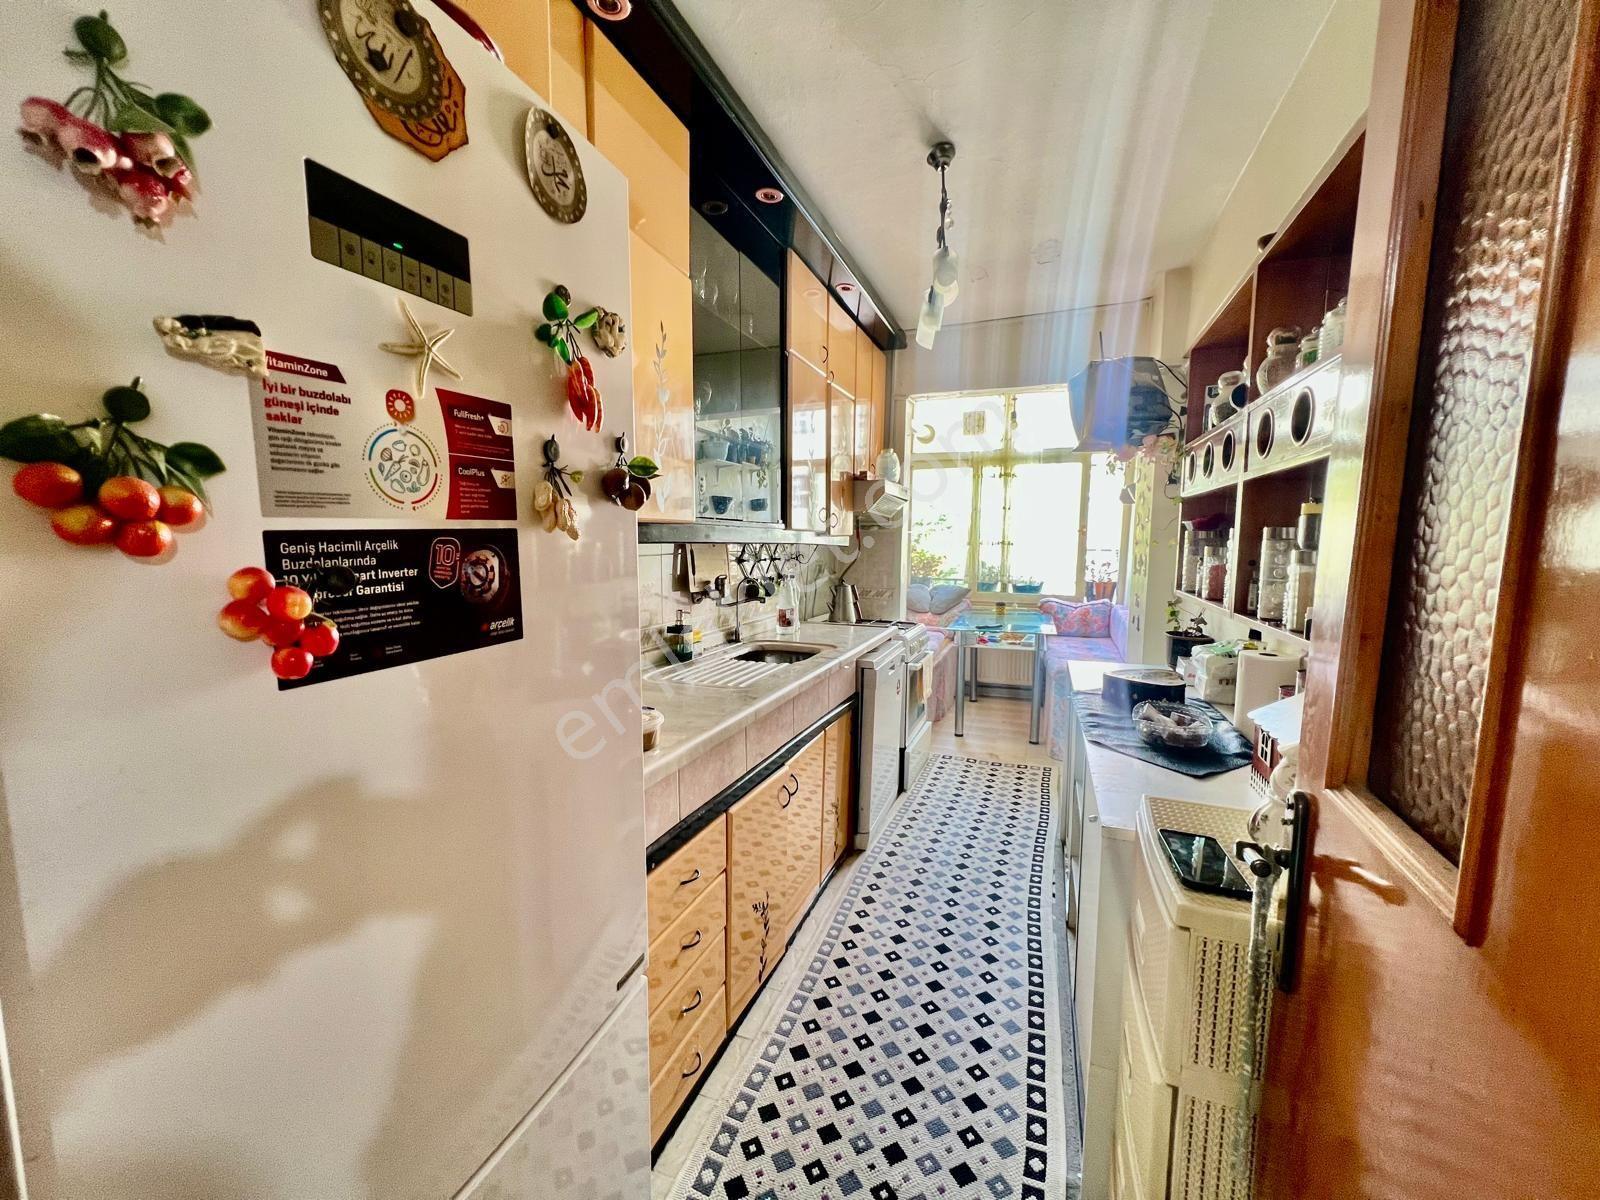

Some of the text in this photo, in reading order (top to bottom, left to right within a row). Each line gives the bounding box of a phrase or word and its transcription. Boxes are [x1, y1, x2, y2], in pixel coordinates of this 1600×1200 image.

[280, 382, 296, 396] bir
[299, 386, 351, 405] buzdolabı
[264, 396, 340, 416] güneşi içinde
[265, 411, 303, 424] saklar
[458, 467, 485, 477] CoolPlus
[280, 539, 399, 556] Geniş Hacimli Arçelik
[436, 544, 456, 566] 10
[378, 567, 419, 579] Inverter
[356, 581, 405, 596] Garantisi
